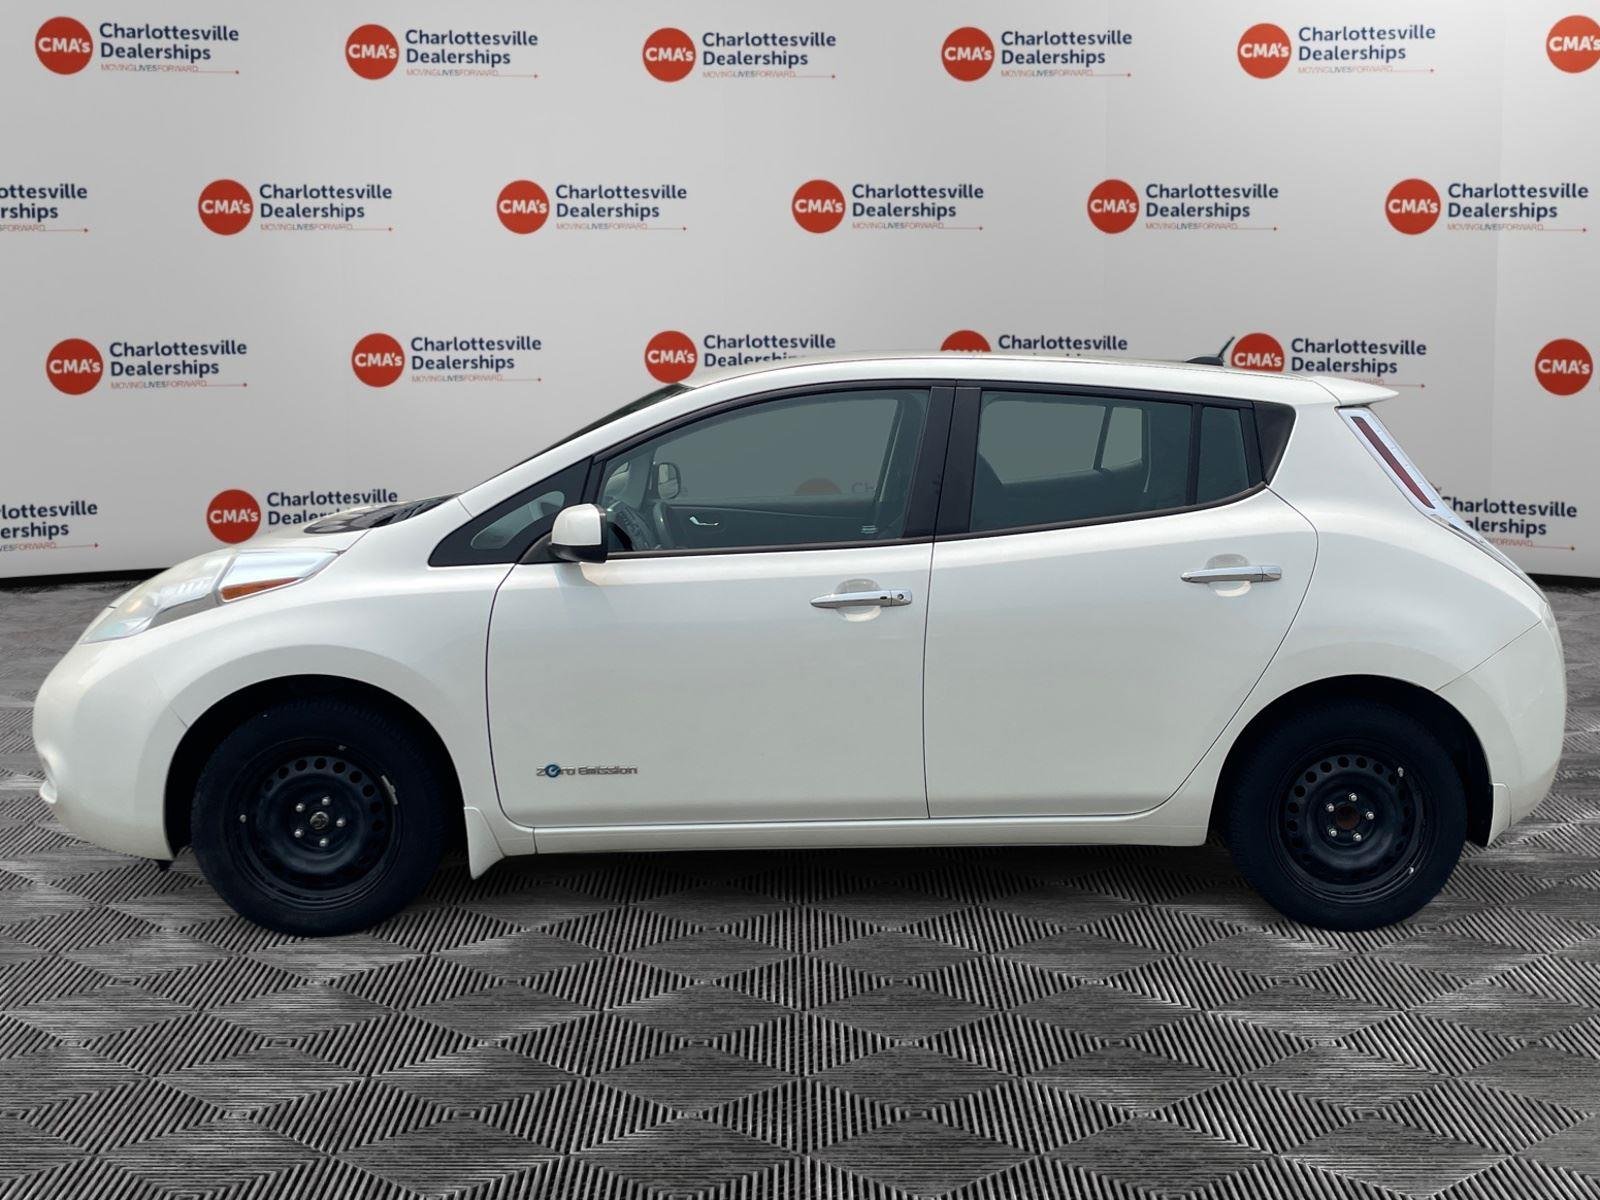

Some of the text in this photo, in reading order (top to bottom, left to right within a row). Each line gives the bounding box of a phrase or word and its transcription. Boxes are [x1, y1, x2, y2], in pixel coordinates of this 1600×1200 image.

[99, 22, 239, 42] Charlottesville
[405, 29, 538, 46] Charlottesville
[702, 31, 836, 47] Charlottesville
[1001, 30, 1132, 46] Charlottesville
[1298, 25, 1436, 42] Charlottesville
[38, 37, 91, 54] CMA's
[348, 44, 398, 60] CMA's
[1240, 42, 1289, 59] CMA's
[1549, 35, 1600, 52] CMA's
[100, 43, 211, 63] Dealerships
[406, 48, 511, 67] Dealerships
[645, 47, 694, 62] CMA's
[703, 51, 808, 68] Dealerships
[944, 46, 993, 61] CMA's
[1001, 50, 1106, 67] Dealerships
[1299, 45, 1406, 62] Dealerships
[259, 183, 392, 199] Charlottesville
[555, 184, 687, 199] Charlottesville
[852, 183, 984, 199] Charlottesville
[1145, 183, 1279, 199] Charlottesville
[1448, 182, 1589, 199] Charlottesville
[1, 203, 59, 223] rships
[201, 199, 251, 214] CMA's
[260, 203, 365, 221] Dealerships
[499, 199, 547, 214] CMA's
[556, 203, 660, 221] Dealerships
[795, 199, 844, 214] CMA's
[853, 203, 957, 220] Dealerships
[1090, 199, 1137, 214] CMA's
[1146, 203, 1250, 220] Dealerships
[1388, 198, 1438, 214] CMA's
[1448, 203, 1558, 221] Dealerships
[109, 339, 247, 358] Charlottesville
[410, 335, 542, 352] Charlottesville
[703, 334, 836, 349] Charlottesville
[998, 334, 1128, 350] Charlottesville
[1291, 338, 1427, 355] Charlottesville
[354, 352, 402, 368] CMA's
[411, 355, 515, 372] Dealerships
[647, 350, 696, 364] CMA's
[1234, 352, 1282, 367] CMA's
[49, 359, 101, 374] CMA's
[110, 360, 220, 378] Dealerships
[1291, 357, 1398, 377] Dealerships
[1537, 358, 1591, 375] CMA's
[266, 488, 398, 507] Charlottesville
[0, 500, 98, 520] lottesville
[210, 509, 259, 524] CMA's
[0, 522, 69, 541] erships
